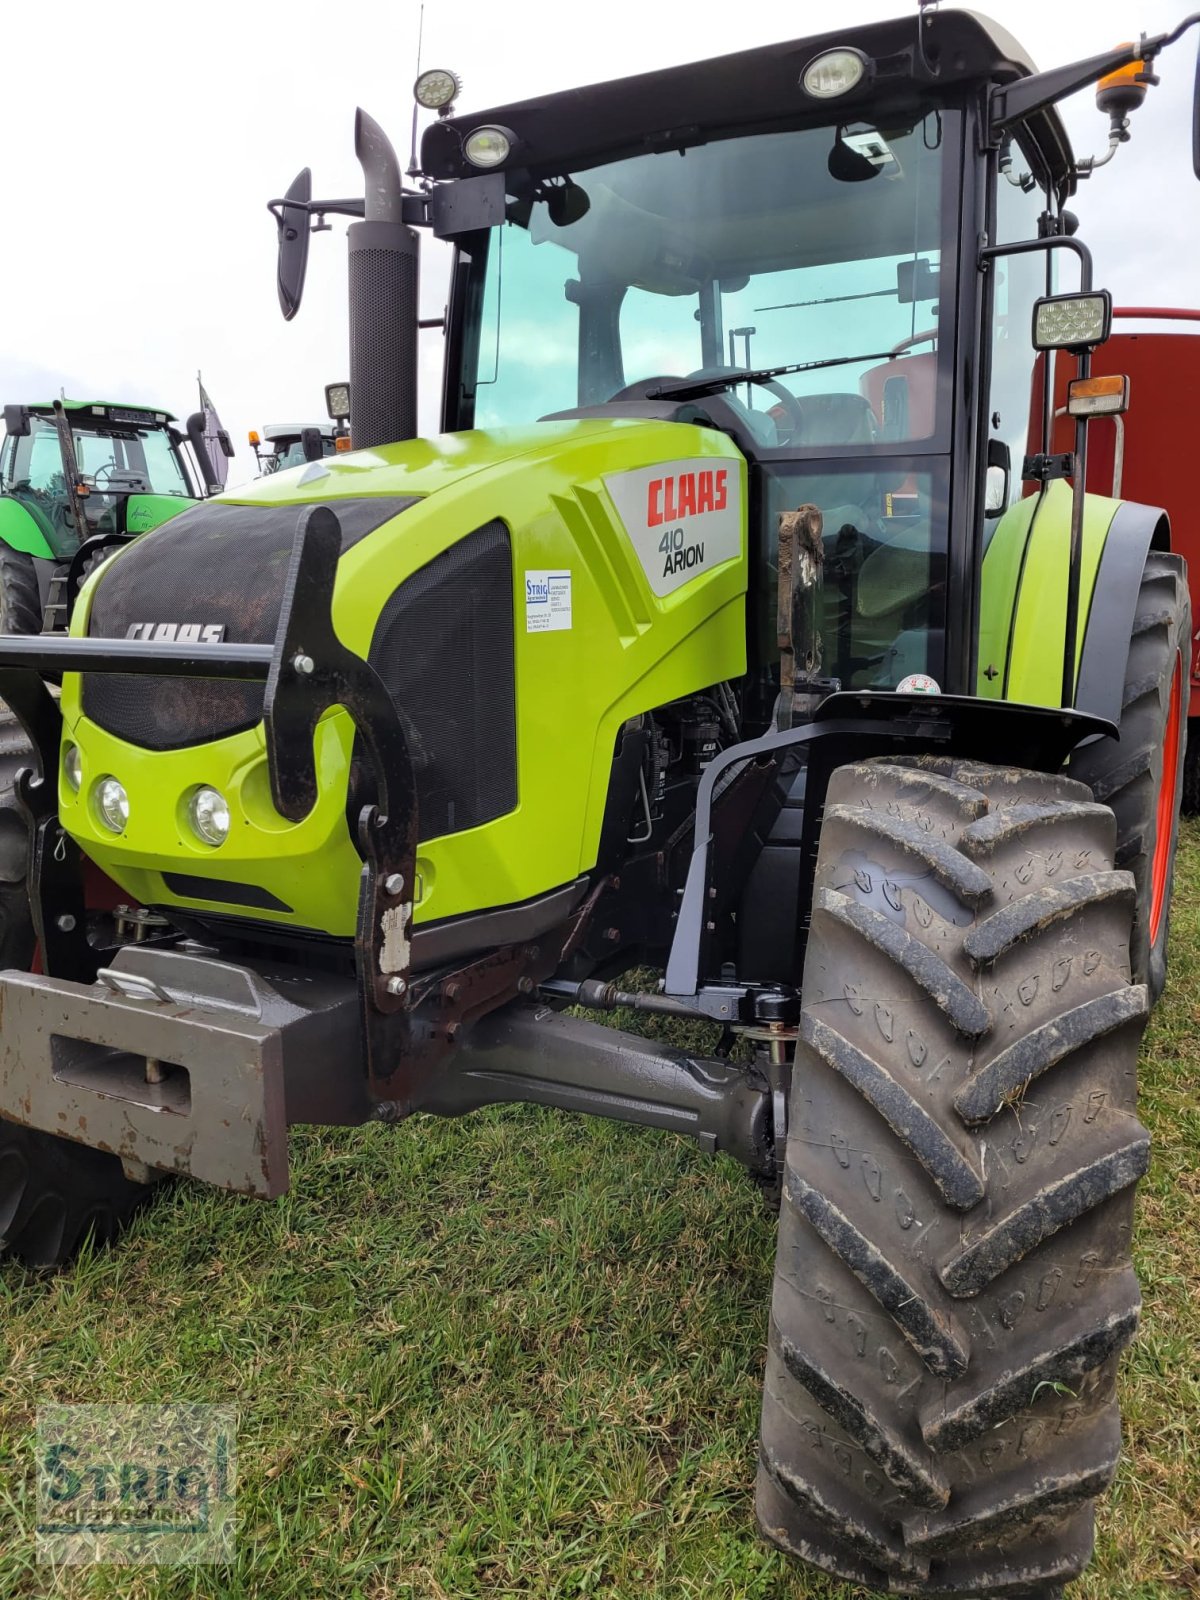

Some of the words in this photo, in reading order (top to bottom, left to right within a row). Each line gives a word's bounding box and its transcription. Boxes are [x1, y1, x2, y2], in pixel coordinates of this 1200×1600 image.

[648, 469, 727, 528] CLAAS
[658, 528, 684, 554] 410
[663, 542, 704, 578] ARION
[126, 623, 225, 643] CLAAS
